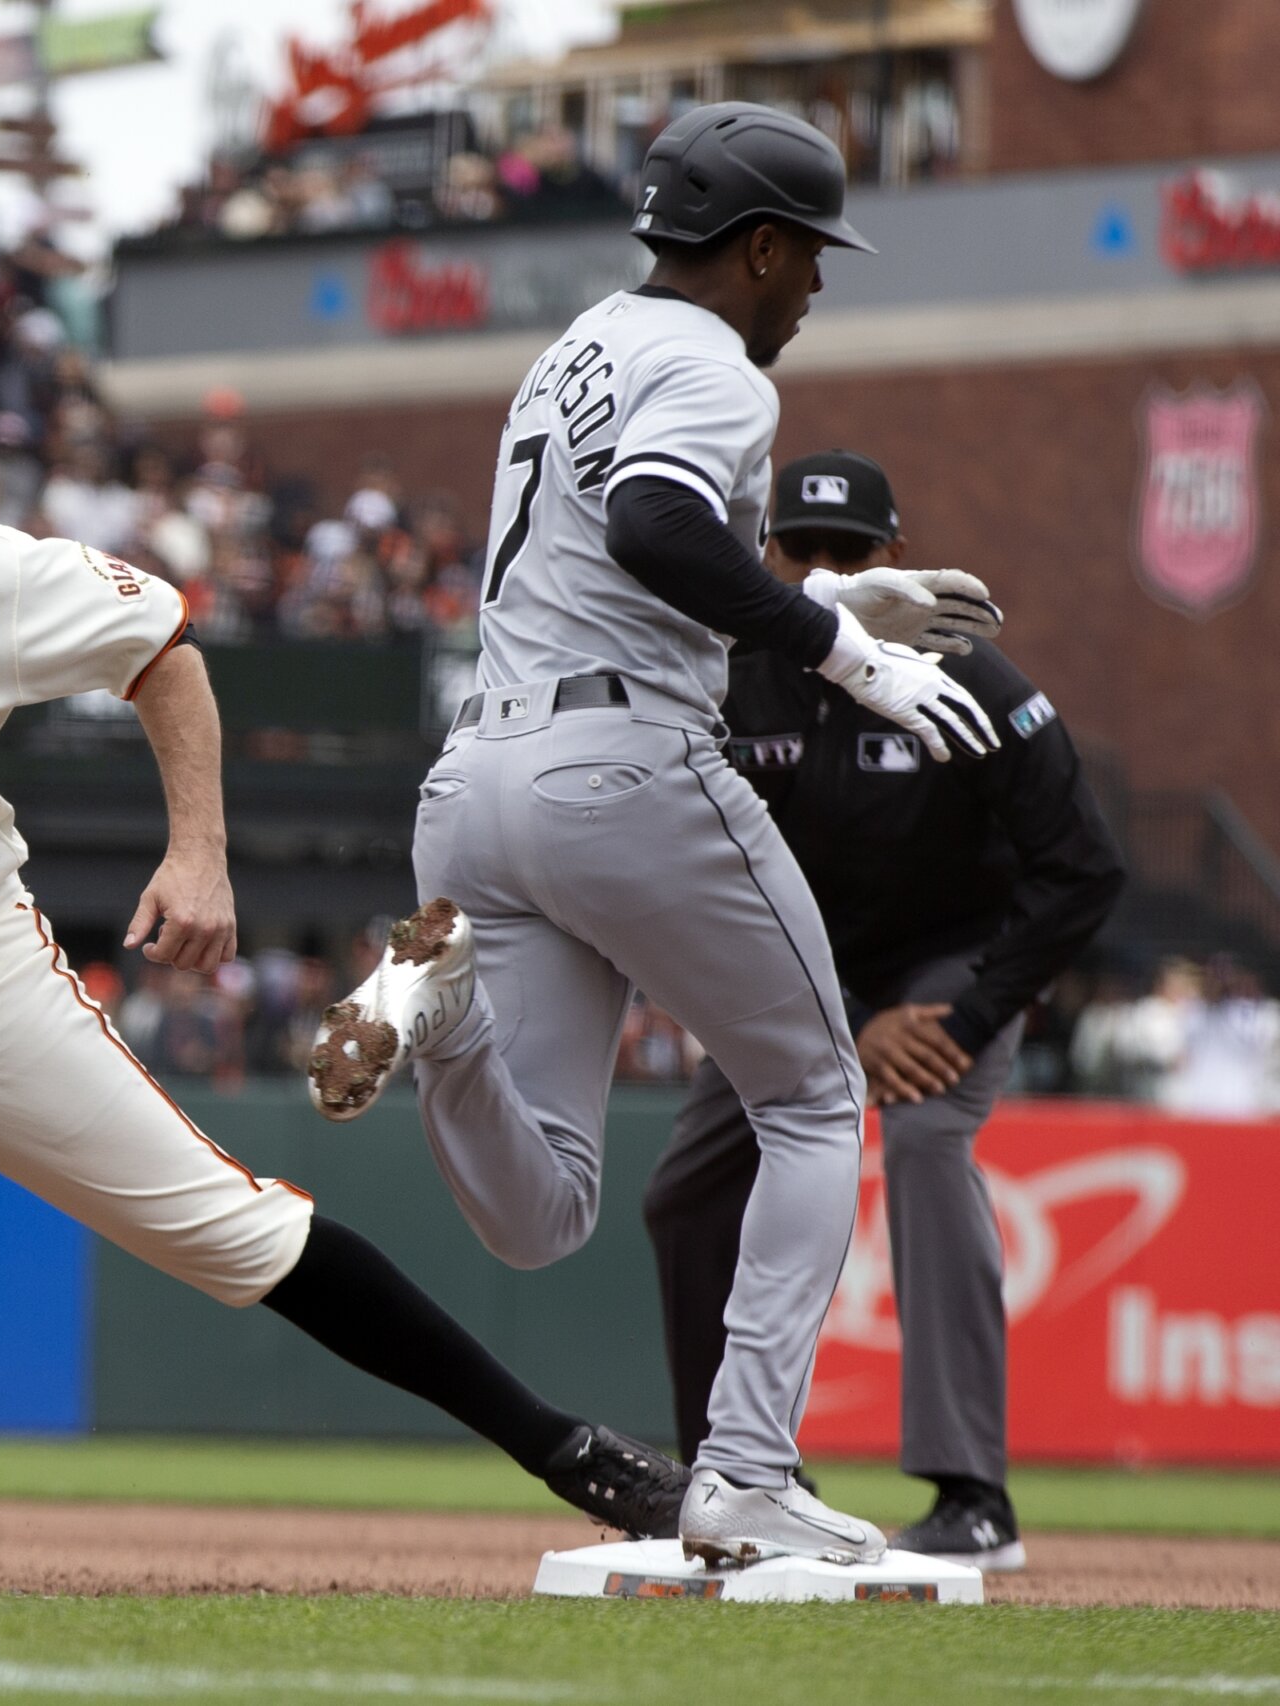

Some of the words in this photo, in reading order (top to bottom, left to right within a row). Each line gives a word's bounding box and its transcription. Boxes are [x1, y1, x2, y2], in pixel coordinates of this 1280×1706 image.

[643, 185, 658, 210] 7
[505, 338, 617, 492] DERSON
[483, 432, 550, 605] 7
[701, 1483, 719, 1504] 7
